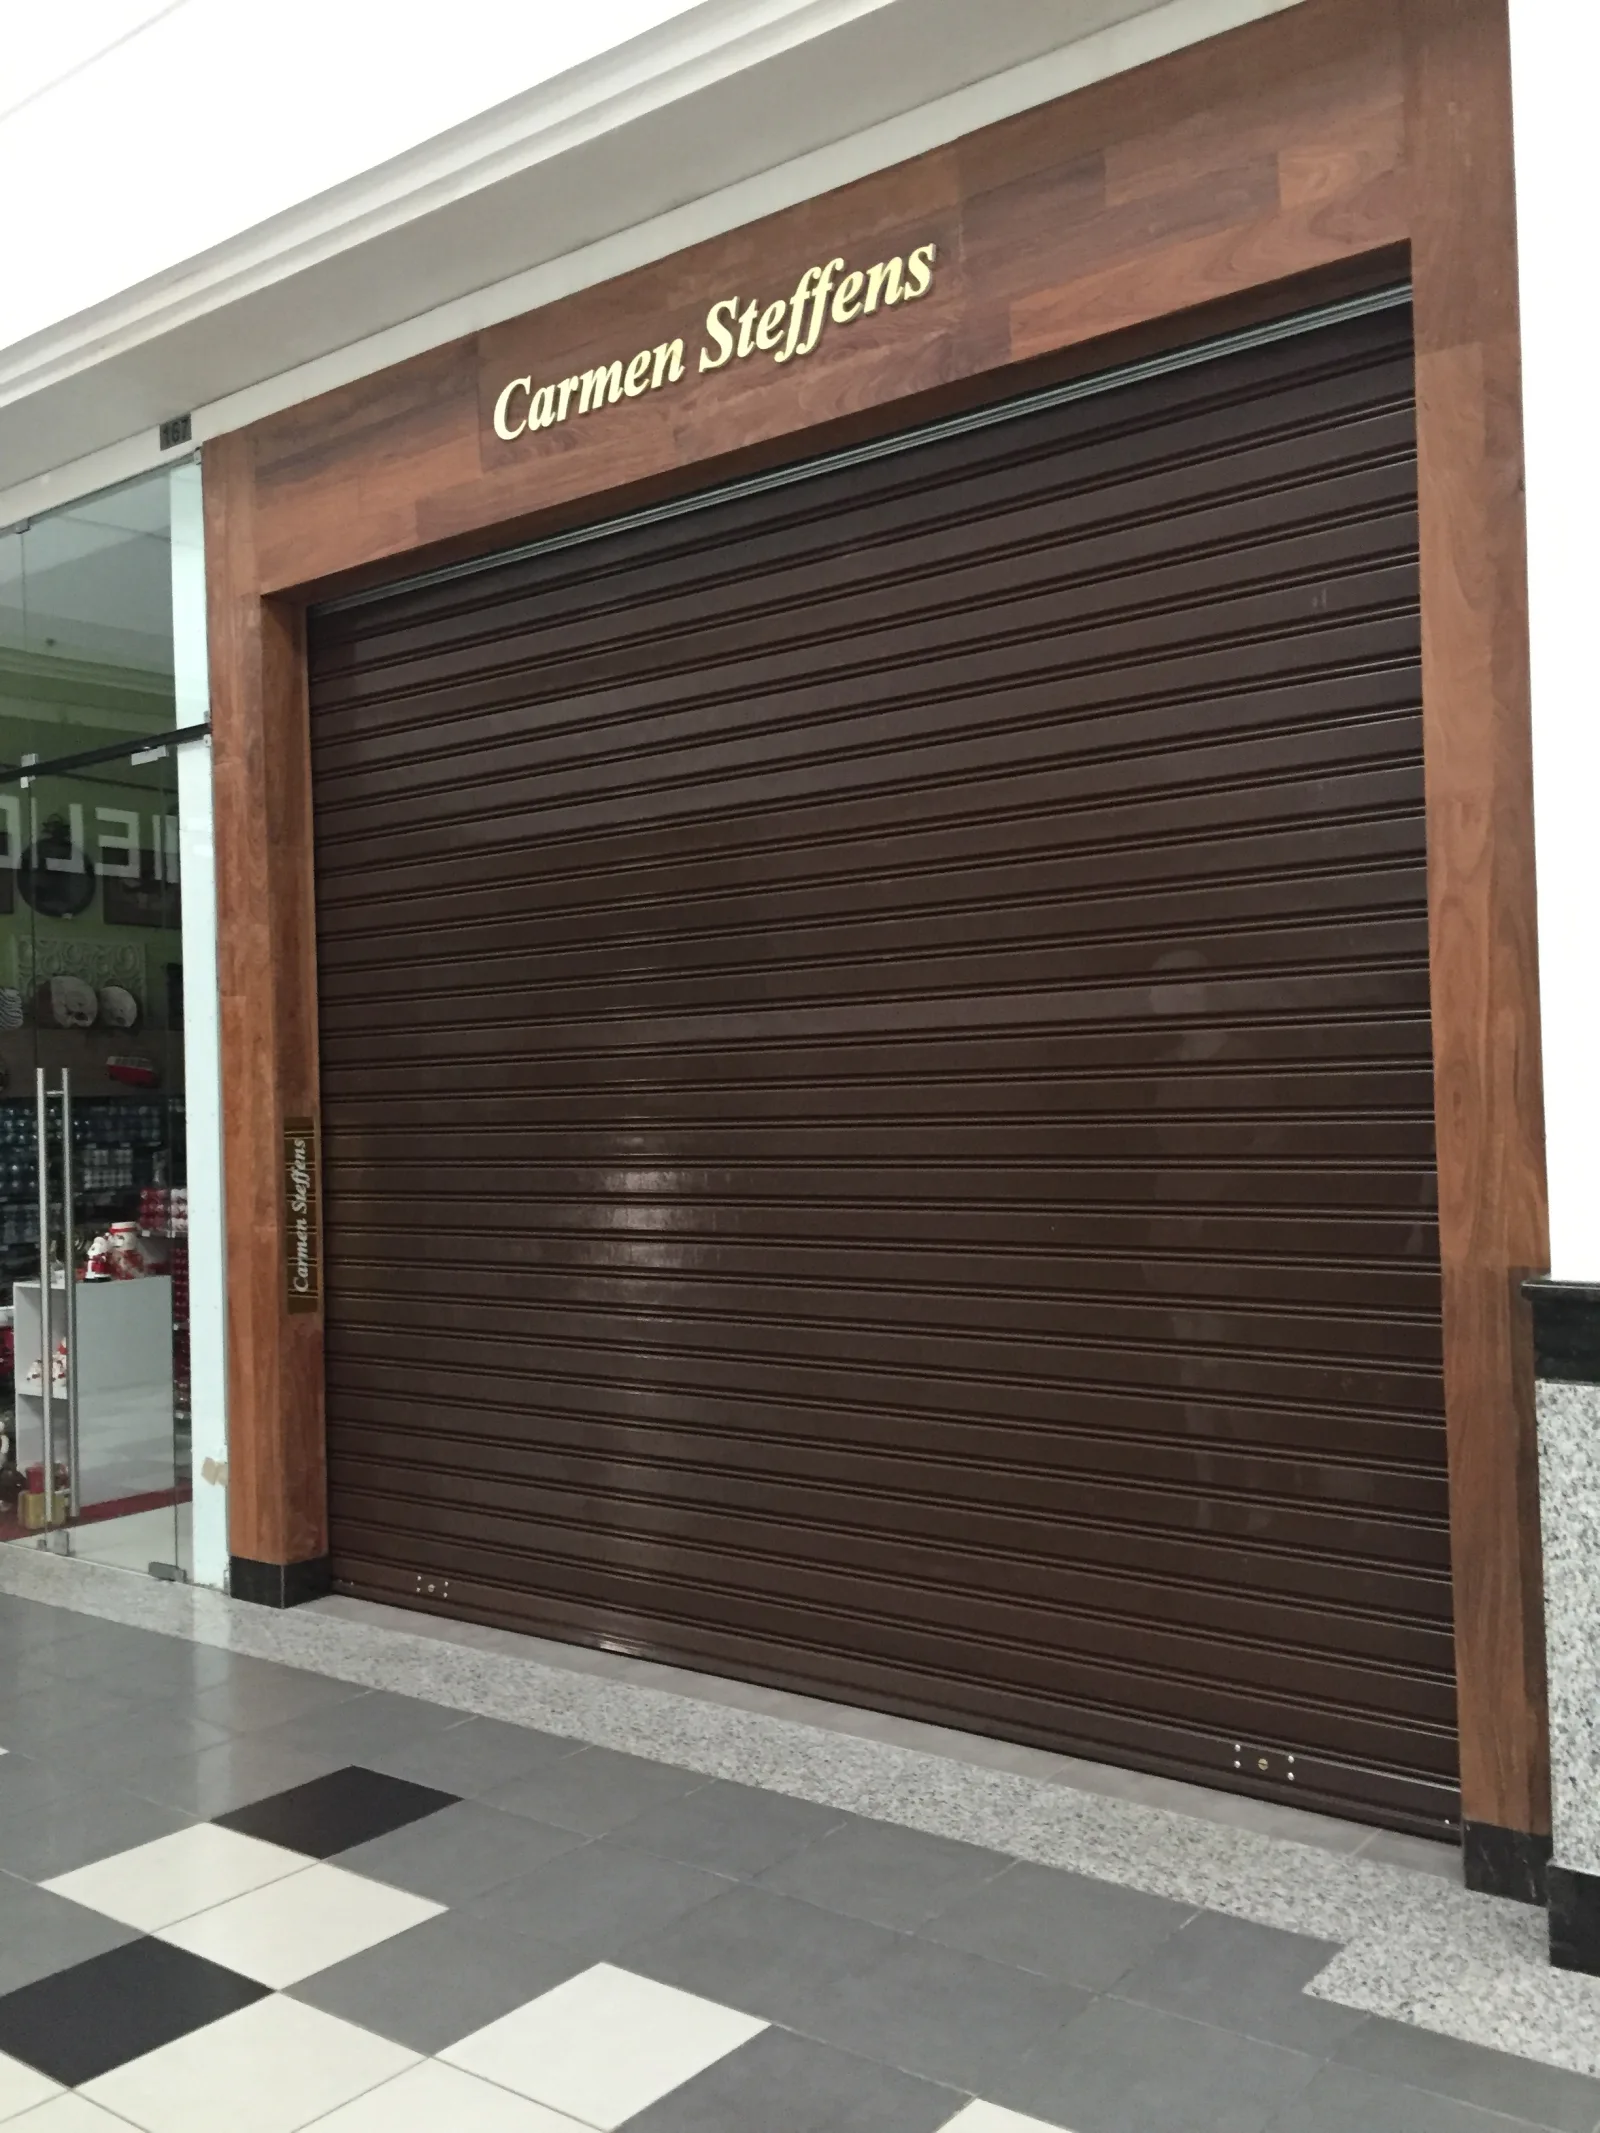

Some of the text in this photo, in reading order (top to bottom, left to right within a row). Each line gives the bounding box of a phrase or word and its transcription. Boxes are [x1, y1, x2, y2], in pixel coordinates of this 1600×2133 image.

[493, 243, 935, 441] Carmen Steffens
[291, 1139, 310, 1292] Carmen Steffens
